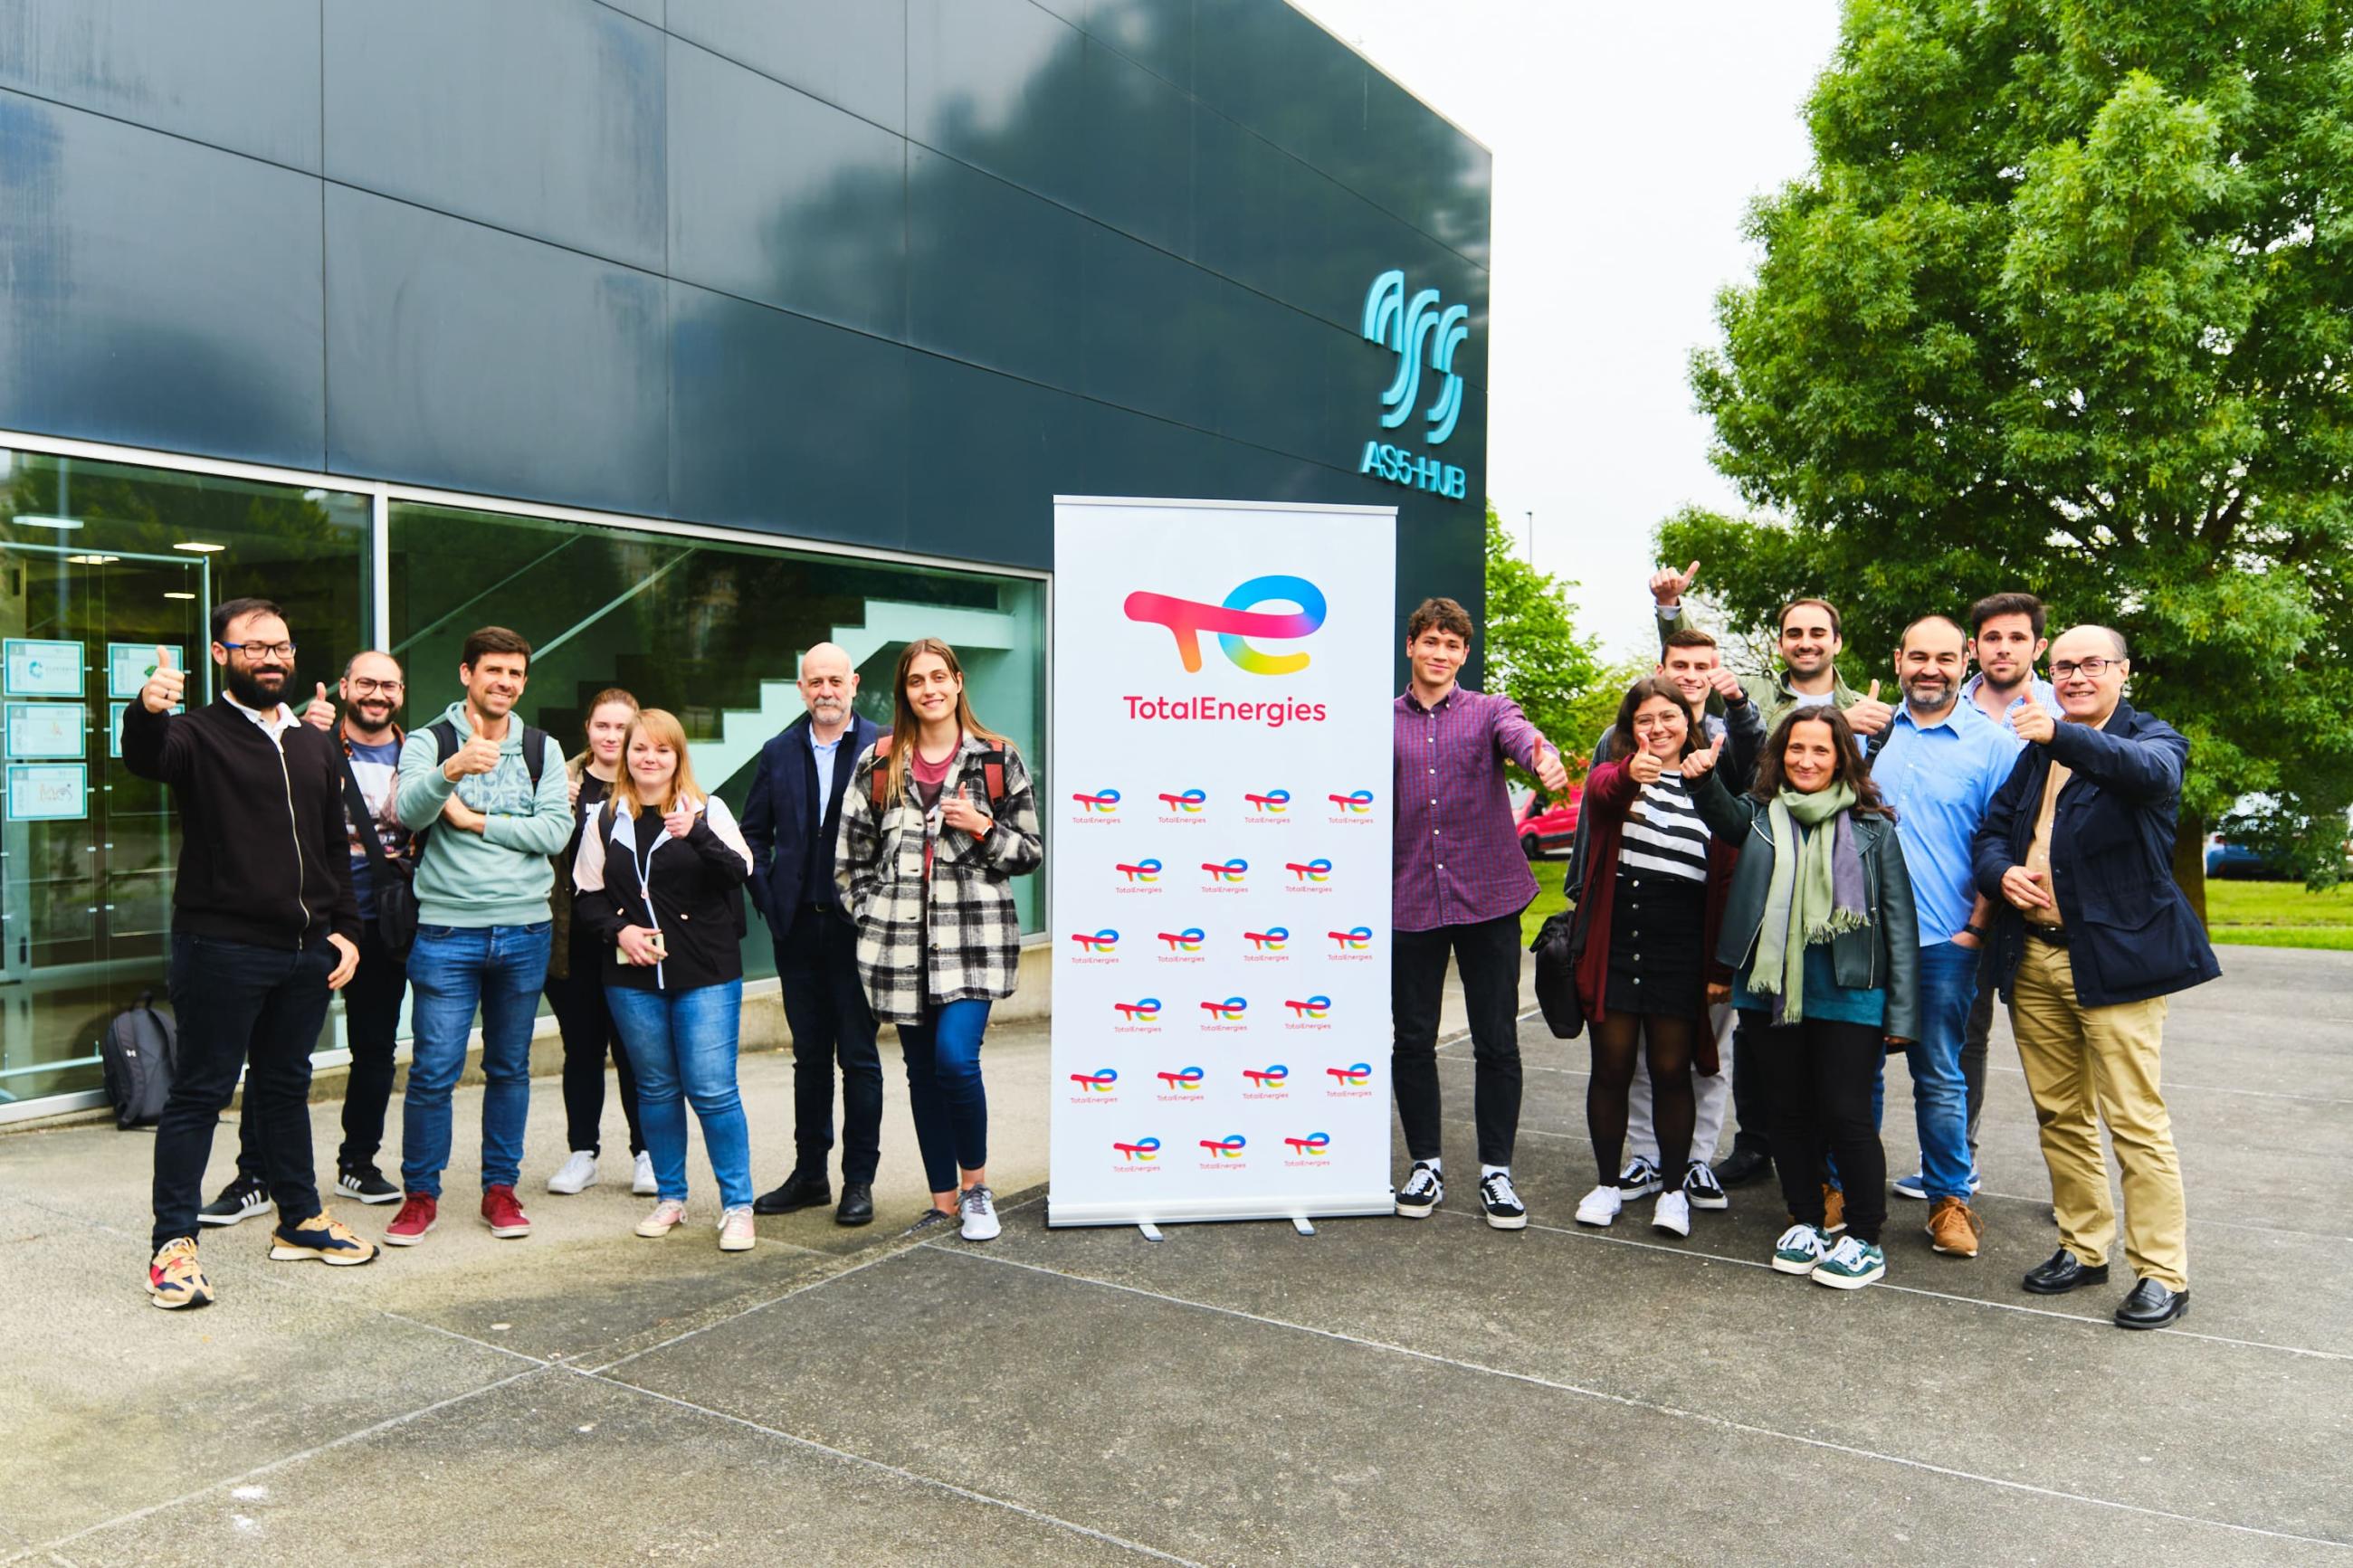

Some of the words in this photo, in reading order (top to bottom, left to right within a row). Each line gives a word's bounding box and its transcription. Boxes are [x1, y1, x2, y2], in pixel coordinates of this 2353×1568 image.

[1360, 441, 1466, 499] AS5-HUB
[1122, 695, 1327, 727] TotalEnergies
[1072, 816, 1121, 825] TotalEnergies
[1157, 816, 1206, 825] TotalEnergies
[1244, 816, 1291, 825] TotalEnergies
[1328, 817, 1374, 825] TotalEnergies
[1115, 887, 1163, 895] TotalEnergies
[1201, 886, 1249, 894] TotalEnergies
[1285, 885, 1333, 894] TotalEnergies
